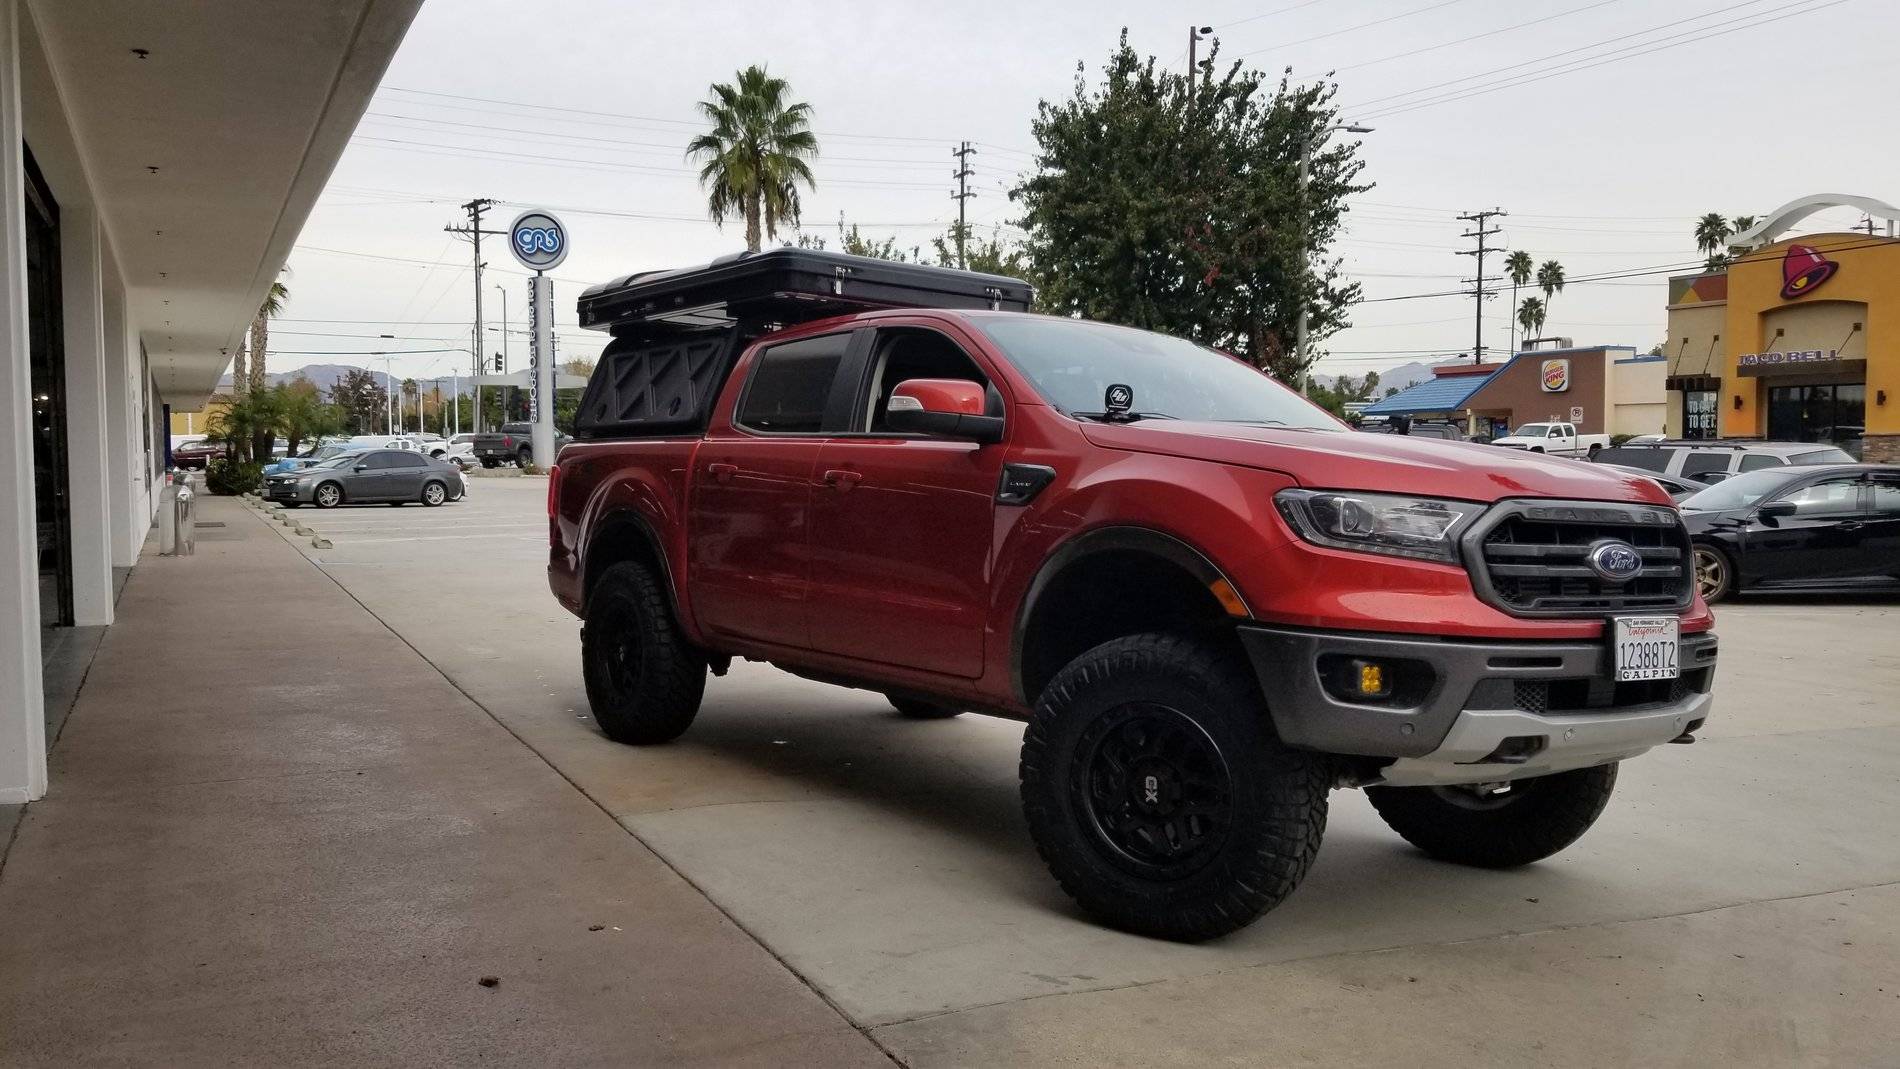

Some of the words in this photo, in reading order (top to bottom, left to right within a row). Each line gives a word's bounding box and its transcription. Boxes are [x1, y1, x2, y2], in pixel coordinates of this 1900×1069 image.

[1737, 351, 1784, 365] TACO
[1787, 349, 1842, 363] BELL
[1546, 371, 1565, 383] KING
[1689, 400, 1698, 413] TO
[1689, 414, 1699, 428] TO
[1610, 549, 1635, 569] Ford
[1620, 641, 1675, 670] 12388T2
[1622, 669, 1676, 680] GALPIN
